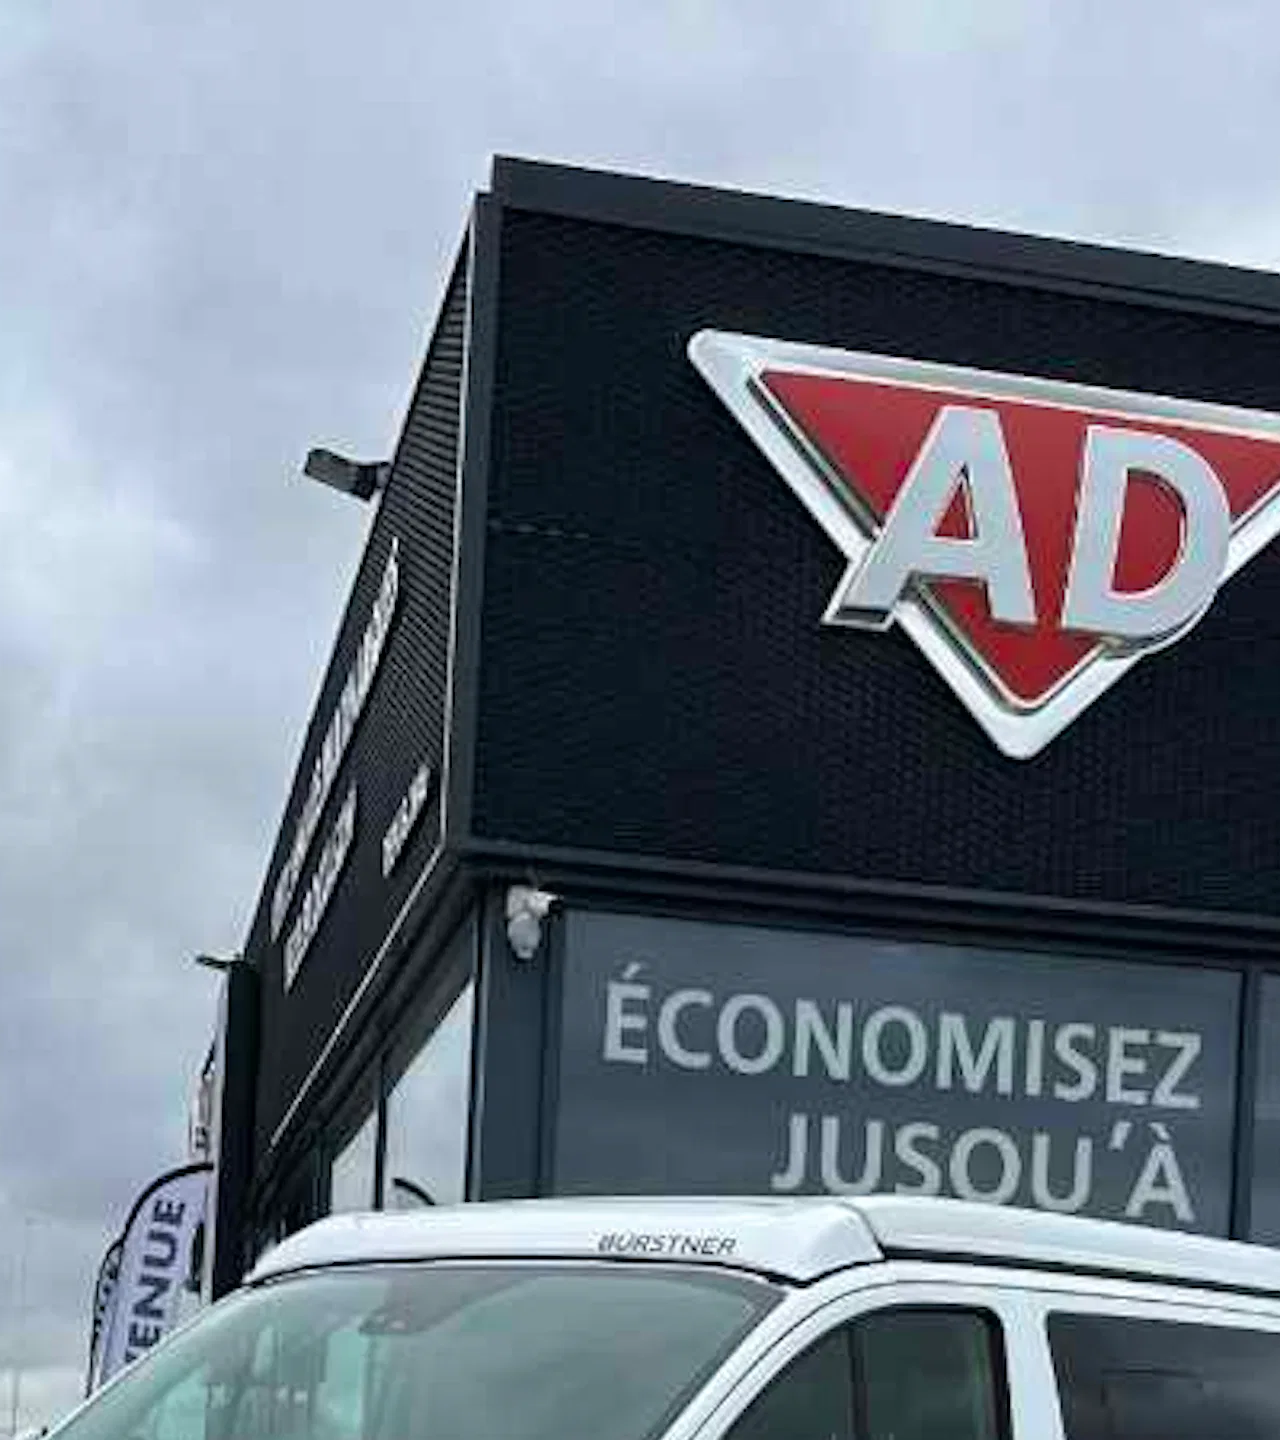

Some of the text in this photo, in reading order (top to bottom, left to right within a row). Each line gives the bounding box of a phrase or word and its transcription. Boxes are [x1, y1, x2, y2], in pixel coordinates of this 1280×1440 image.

[822, 405, 1231, 655] AD
[602, 962, 1202, 1110] ÉCONOMISEZ
[124, 1199, 187, 1363] ENUE
